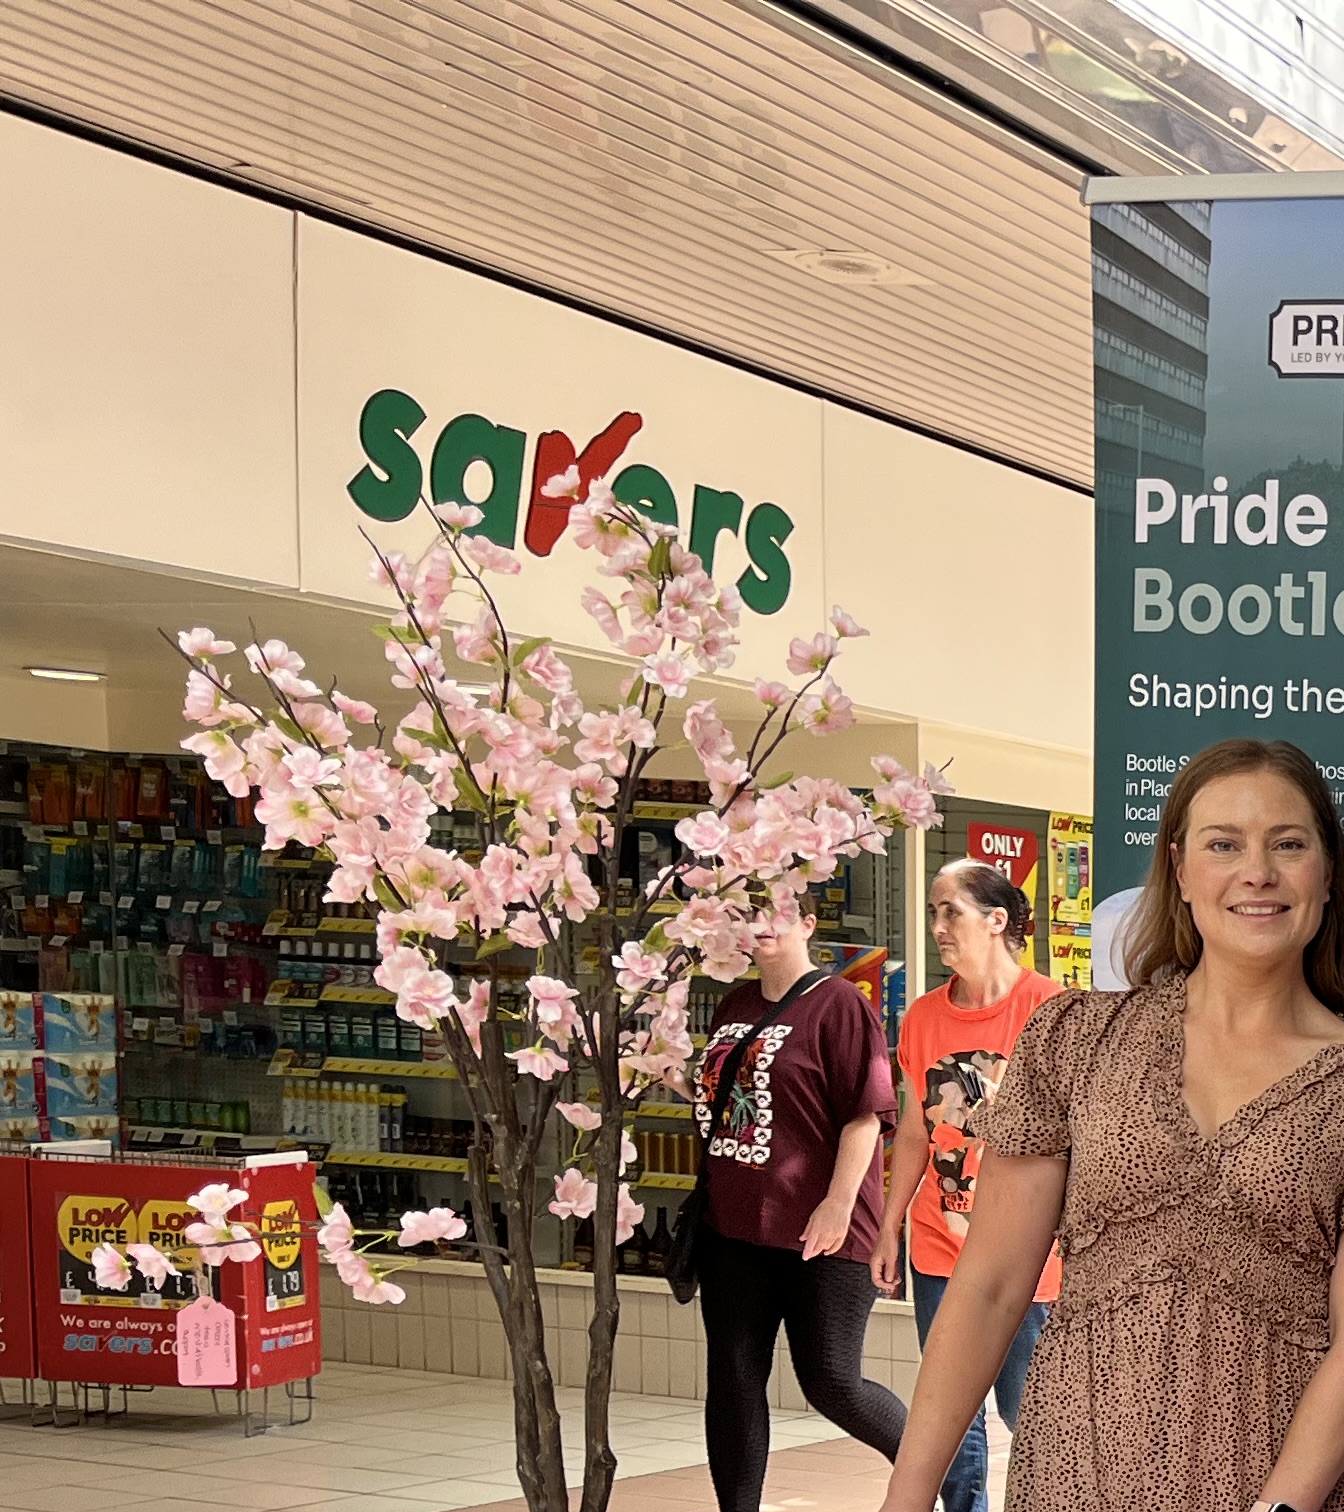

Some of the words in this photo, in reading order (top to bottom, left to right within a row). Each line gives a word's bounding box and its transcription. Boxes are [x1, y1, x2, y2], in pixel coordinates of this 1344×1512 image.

[1290, 351, 1311, 364] LED
[1312, 351, 1332, 364] BY
[1134, 476, 1328, 546] Pride
[1128, 673, 1274, 718] Shaping
[1126, 754, 1176, 773] Bootle
[1126, 780, 1139, 796] in
[1125, 804, 1160, 822] local
[981, 832, 1025, 858] ONLY
[1124, 831, 1158, 846] over
[72, 1202, 131, 1228] LOW
[68, 1227, 127, 1245] PRICE
[60, 1314, 84, 1328] We
[88, 1318, 111, 1328] are
[115, 1316, 163, 1334] always
